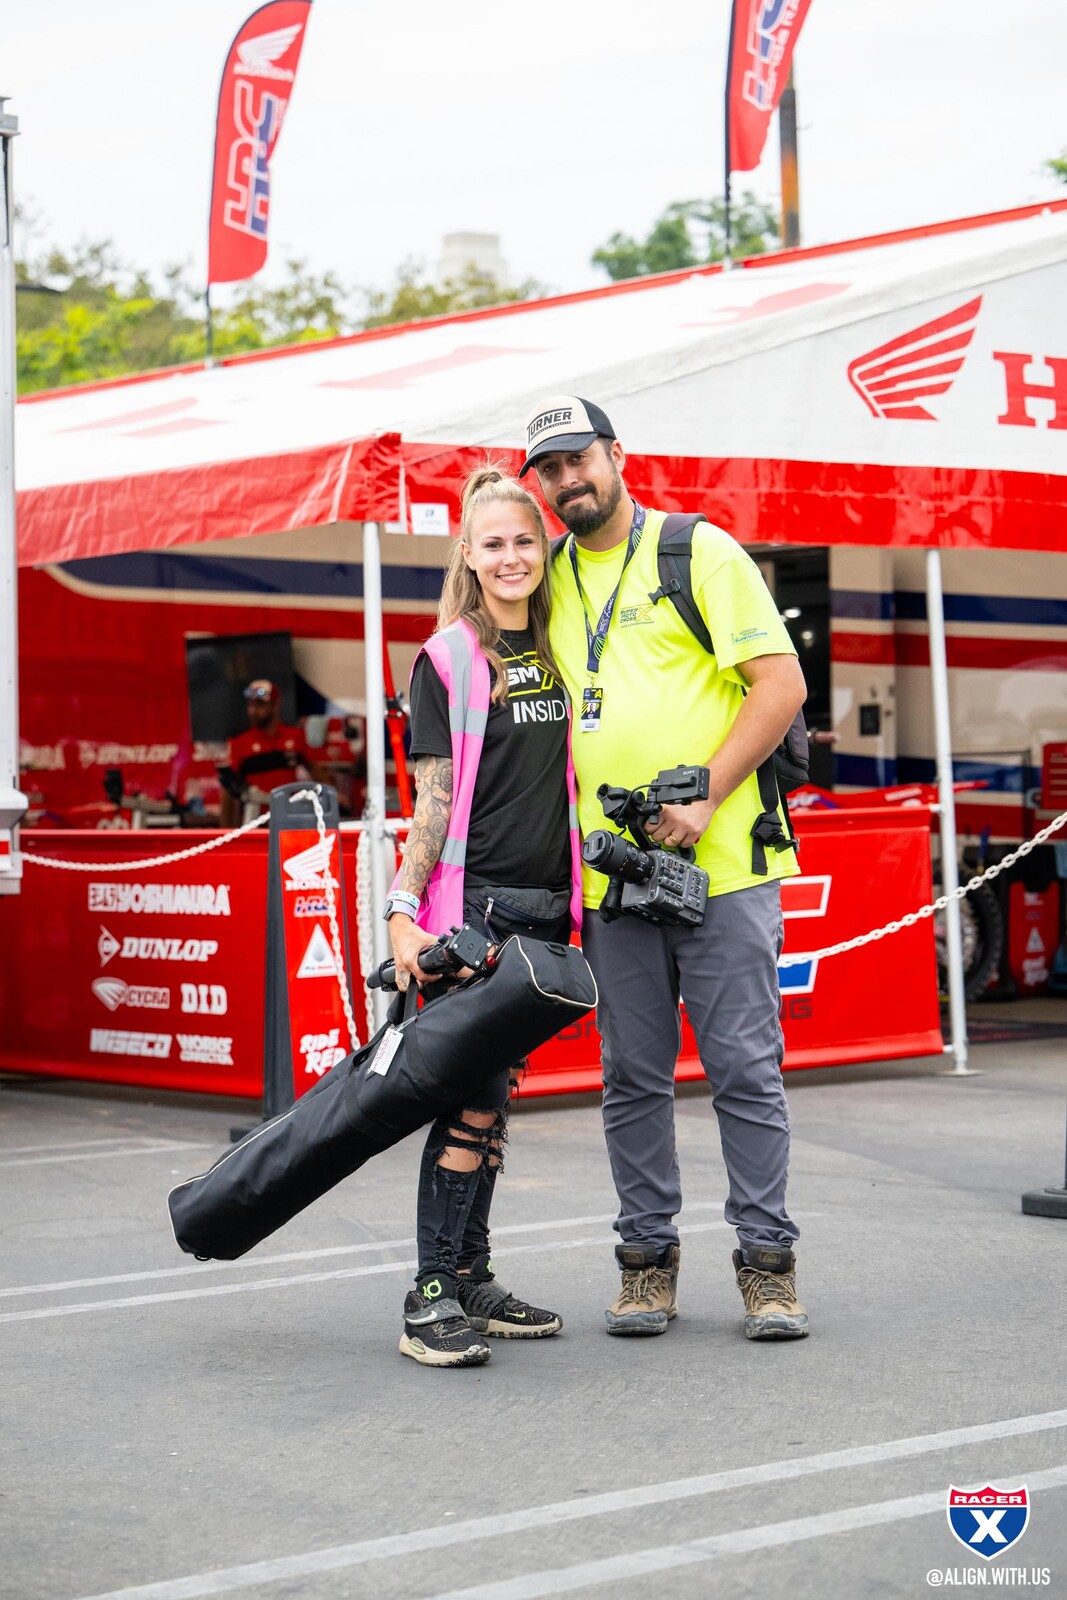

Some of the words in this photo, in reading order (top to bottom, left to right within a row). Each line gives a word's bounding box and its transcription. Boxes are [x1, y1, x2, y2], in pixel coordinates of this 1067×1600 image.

[526, 408, 573, 444] TURNER
[512, 699, 567, 724] INSID
[118, 883, 232, 916] YOSHIMURA
[120, 936, 219, 962] DUNLOP
[127, 985, 171, 1009] CYCRA
[299, 1027, 341, 1054] RIDE
[304, 1046, 347, 1078] RED
